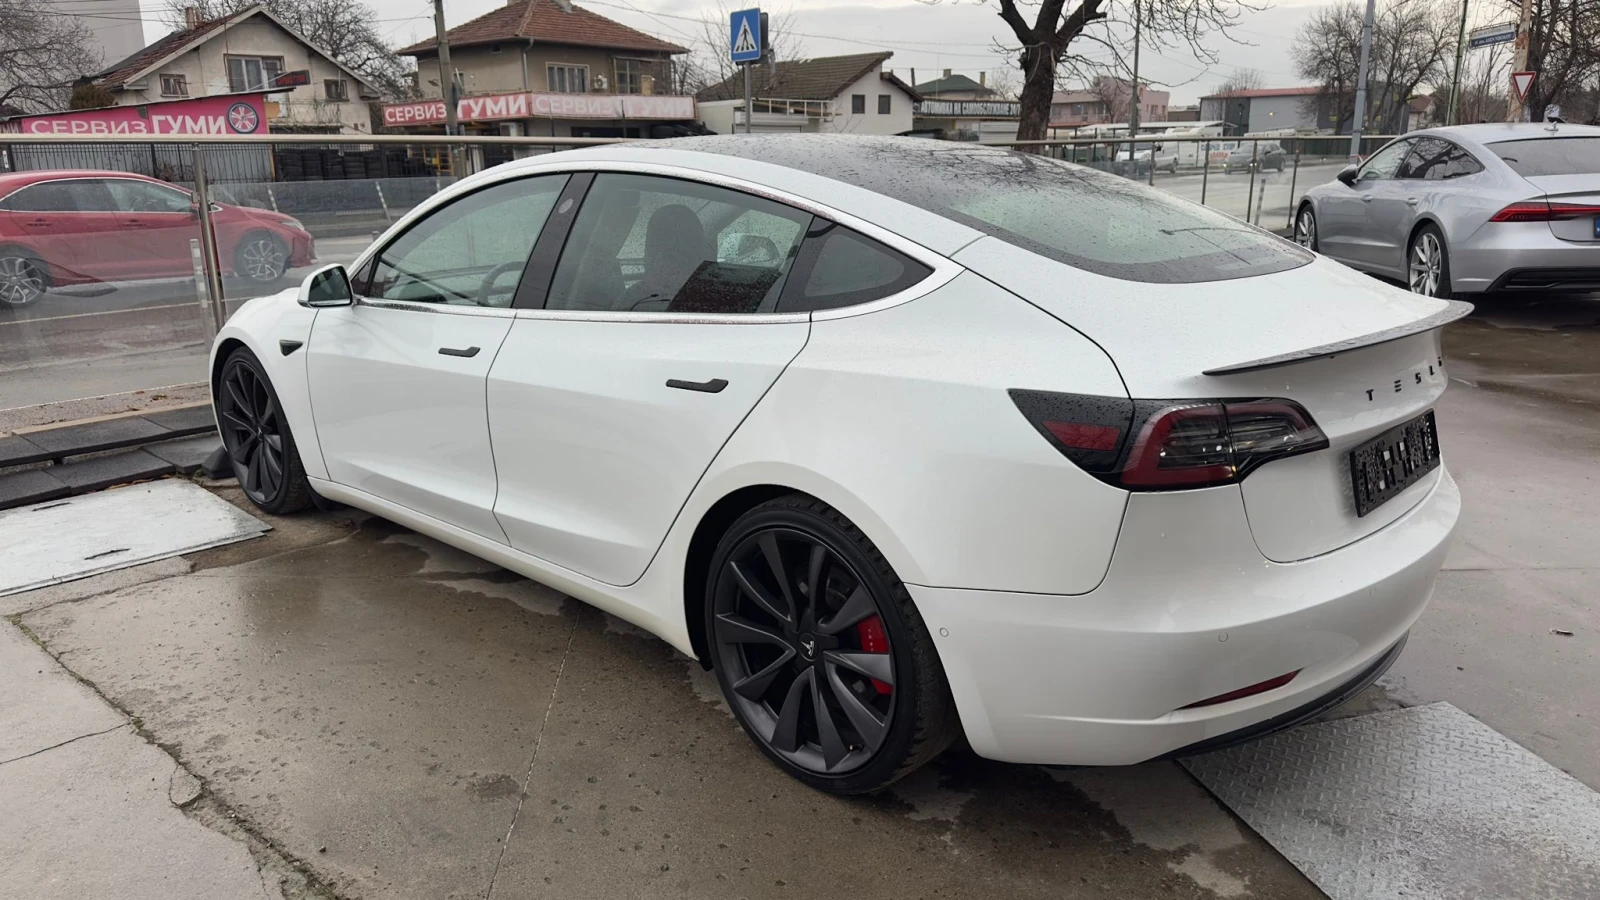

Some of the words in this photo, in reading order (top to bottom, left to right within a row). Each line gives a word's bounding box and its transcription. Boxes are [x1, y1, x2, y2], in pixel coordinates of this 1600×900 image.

[385, 103, 447, 122] СЕРВИЗ
[457, 95, 527, 118] ГУМИ
[535, 97, 615, 114] СЕРВИЗ
[626, 97, 691, 117] ГУМИ
[30, 120, 147, 134] СЕРВИЗ
[151, 115, 227, 134] ГУМИ
